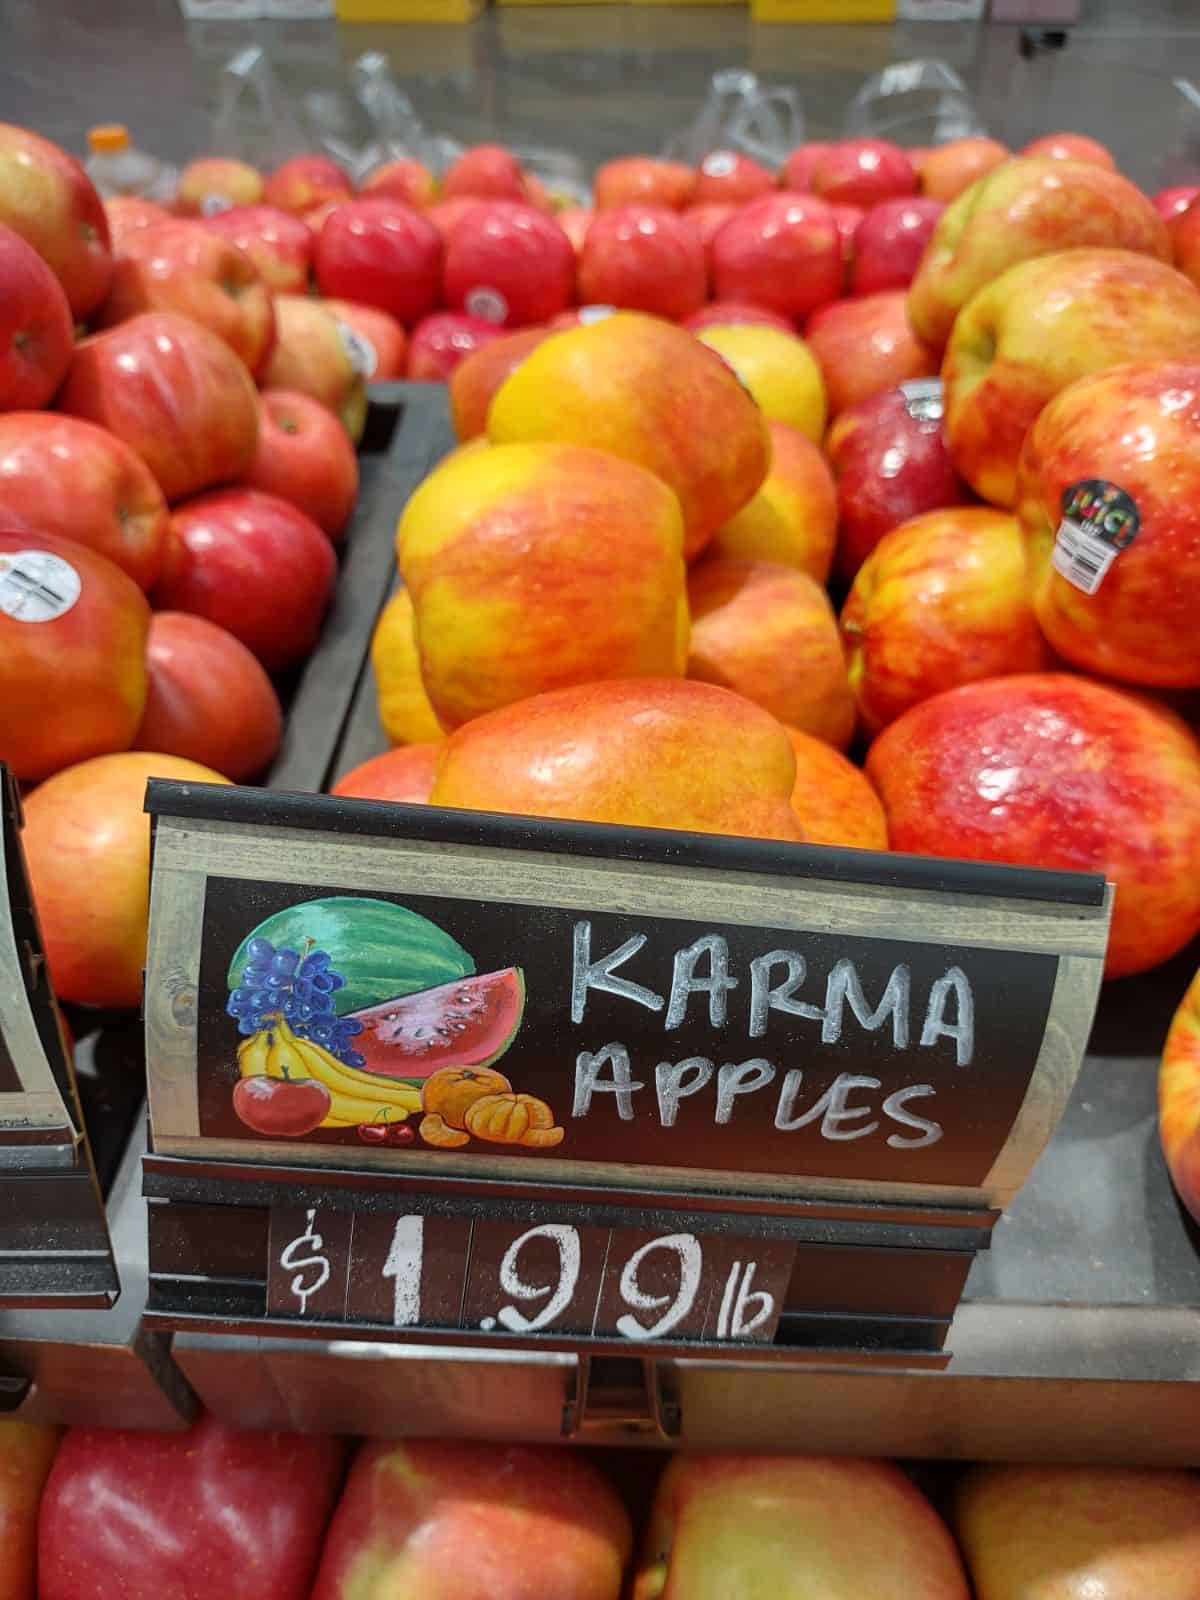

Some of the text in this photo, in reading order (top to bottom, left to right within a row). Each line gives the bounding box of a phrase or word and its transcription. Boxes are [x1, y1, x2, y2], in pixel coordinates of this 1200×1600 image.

[571, 919, 975, 1066] KARMA
[571, 1041, 944, 1149] APPLES
[716, 1260, 774, 1338] lb
